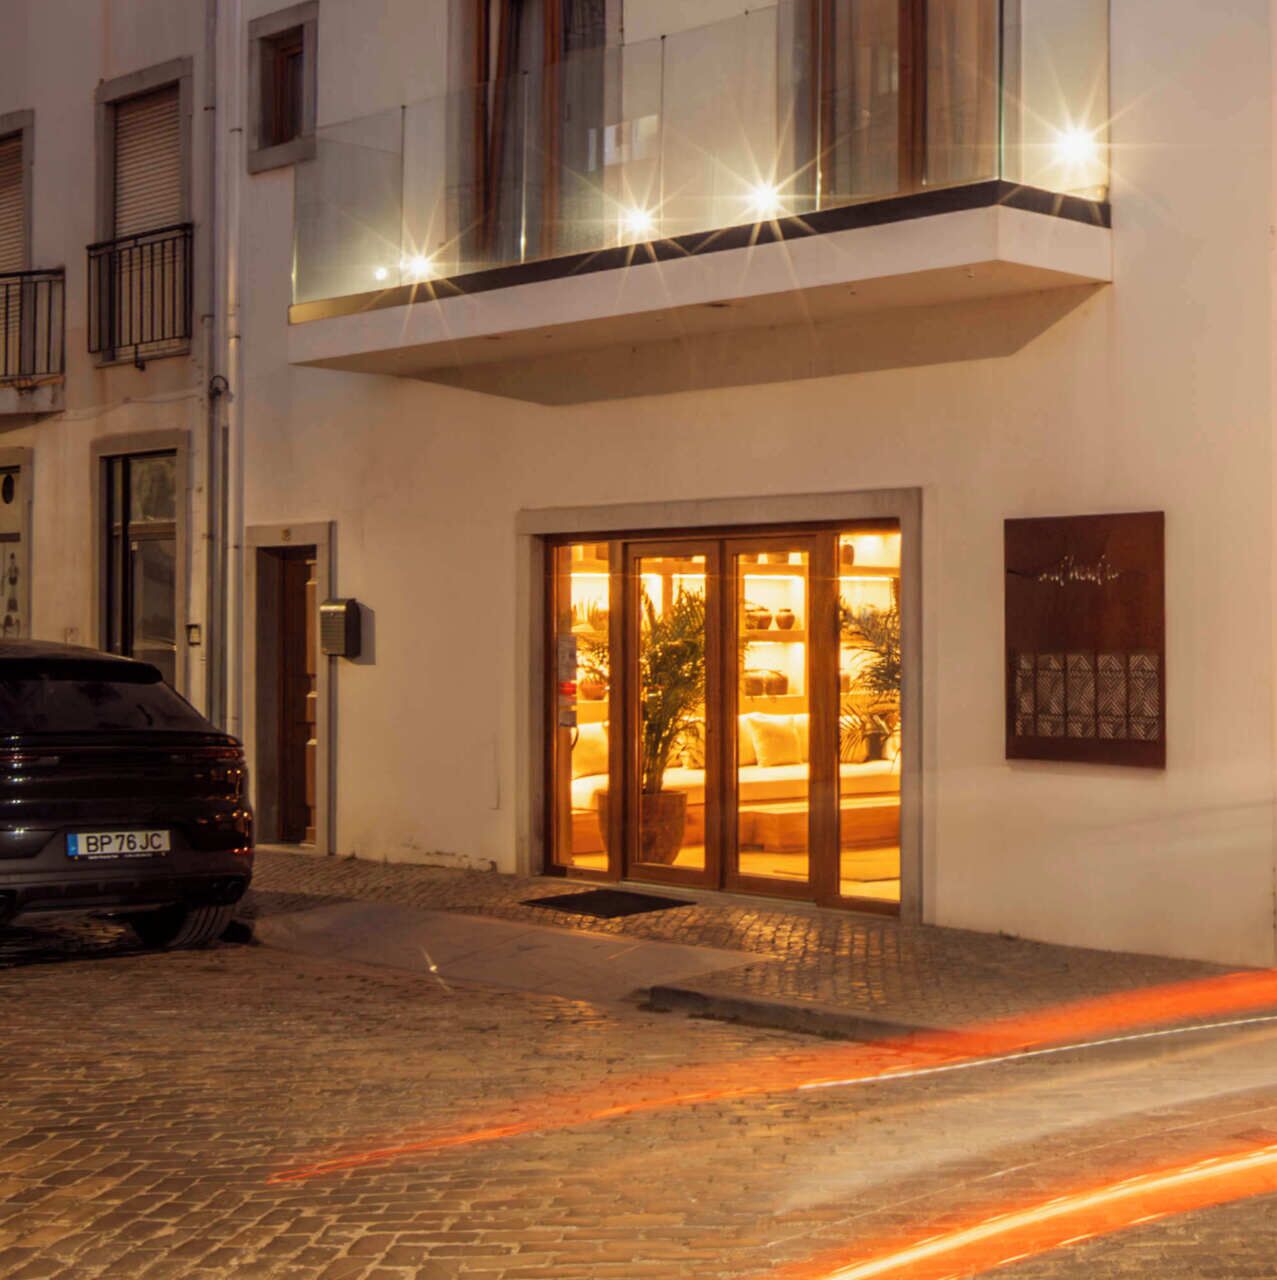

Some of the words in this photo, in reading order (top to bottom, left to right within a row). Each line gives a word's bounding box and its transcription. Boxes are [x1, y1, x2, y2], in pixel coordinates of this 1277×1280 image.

[86, 835, 113, 853] BP
[115, 834, 138, 852] 76
[139, 832, 163, 851] JC
